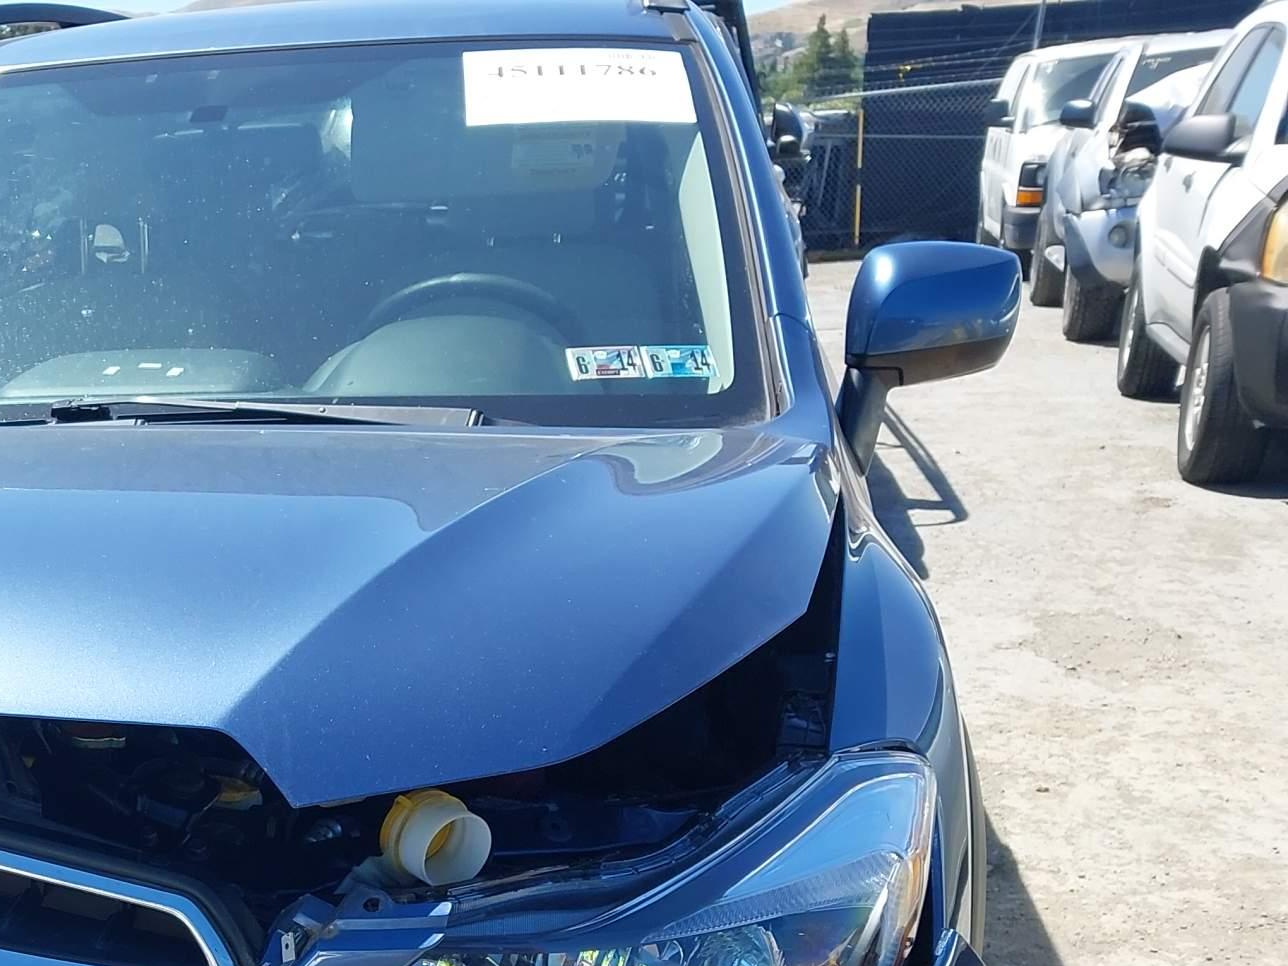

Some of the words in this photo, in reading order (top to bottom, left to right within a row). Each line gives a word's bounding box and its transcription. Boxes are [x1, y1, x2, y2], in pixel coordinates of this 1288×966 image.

[576, 356, 590, 375] 6
[617, 350, 638, 372] 14
[649, 354, 664, 373] 6
[689, 349, 711, 372] 14
